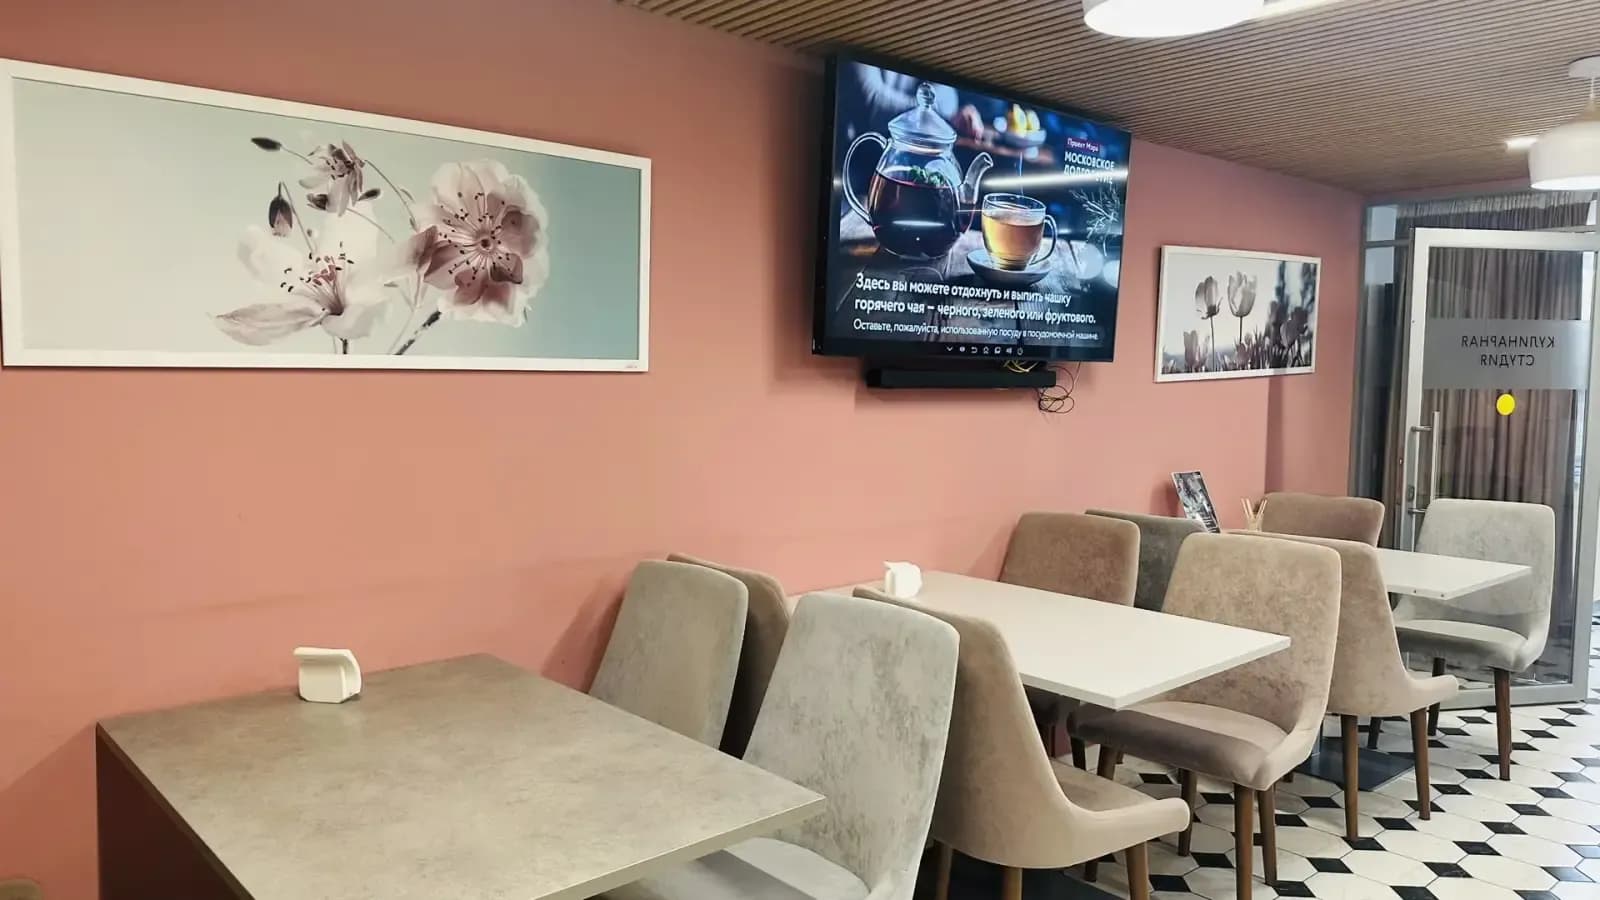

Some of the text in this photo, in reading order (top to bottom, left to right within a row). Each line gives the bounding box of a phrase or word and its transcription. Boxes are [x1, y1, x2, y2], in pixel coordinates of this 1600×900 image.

[1065, 151, 1115, 170] МОСКОВСКОЕ
[1064, 164, 1113, 184] ДОЛГОТИЕ
[856, 272, 1071, 307] Здесь вы можете отдохнуть и выпить чашку
[854, 298, 905, 314] горячего
[907, 302, 925, 314] чая
[937, 304, 981, 319] черного,
[982, 307, 1025, 319] зеленого
[1027, 310, 1043, 321] или
[1044, 308, 1096, 324] фруктового.
[853, 318, 892, 332] Оставьте,
[893, 322, 940, 335] пожалуйста,
[941, 326, 998, 337] использованную
[999, 329, 1021, 338] посуду
